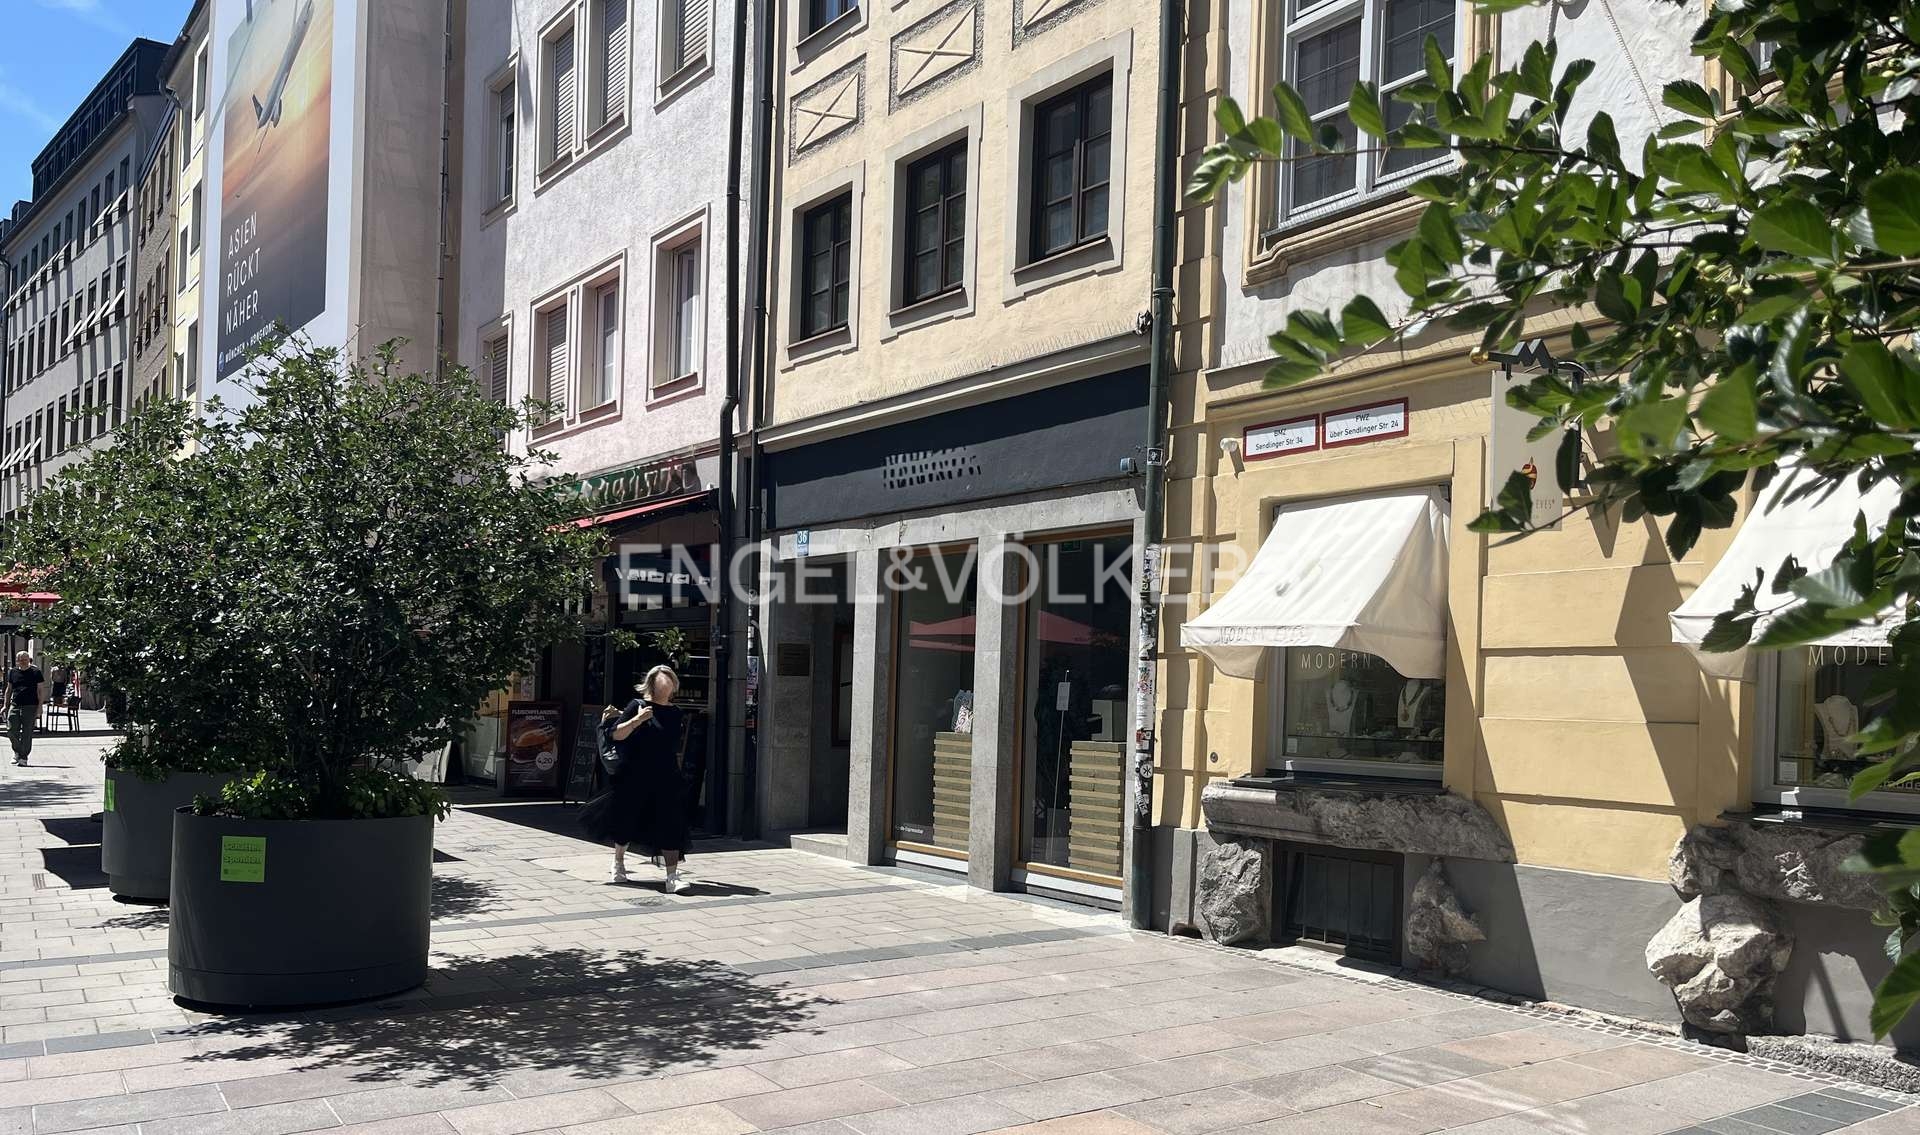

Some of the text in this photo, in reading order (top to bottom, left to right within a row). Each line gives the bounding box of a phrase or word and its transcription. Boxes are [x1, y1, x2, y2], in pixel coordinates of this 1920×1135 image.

[228, 212, 257, 259] ASIEN
[226, 247, 261, 297] RÜCKT
[225, 289, 259, 335] NÄHER
[1329, 430, 1344, 438] über
[1344, 424, 1377, 436] Sendlinger
[1390, 419, 1400, 428] 24
[1255, 440, 1285, 451] Sendlinger
[798, 530, 807, 543] 36
[1301, 652, 1371, 669] MODERN
[1808, 645, 1888, 666] MODE
